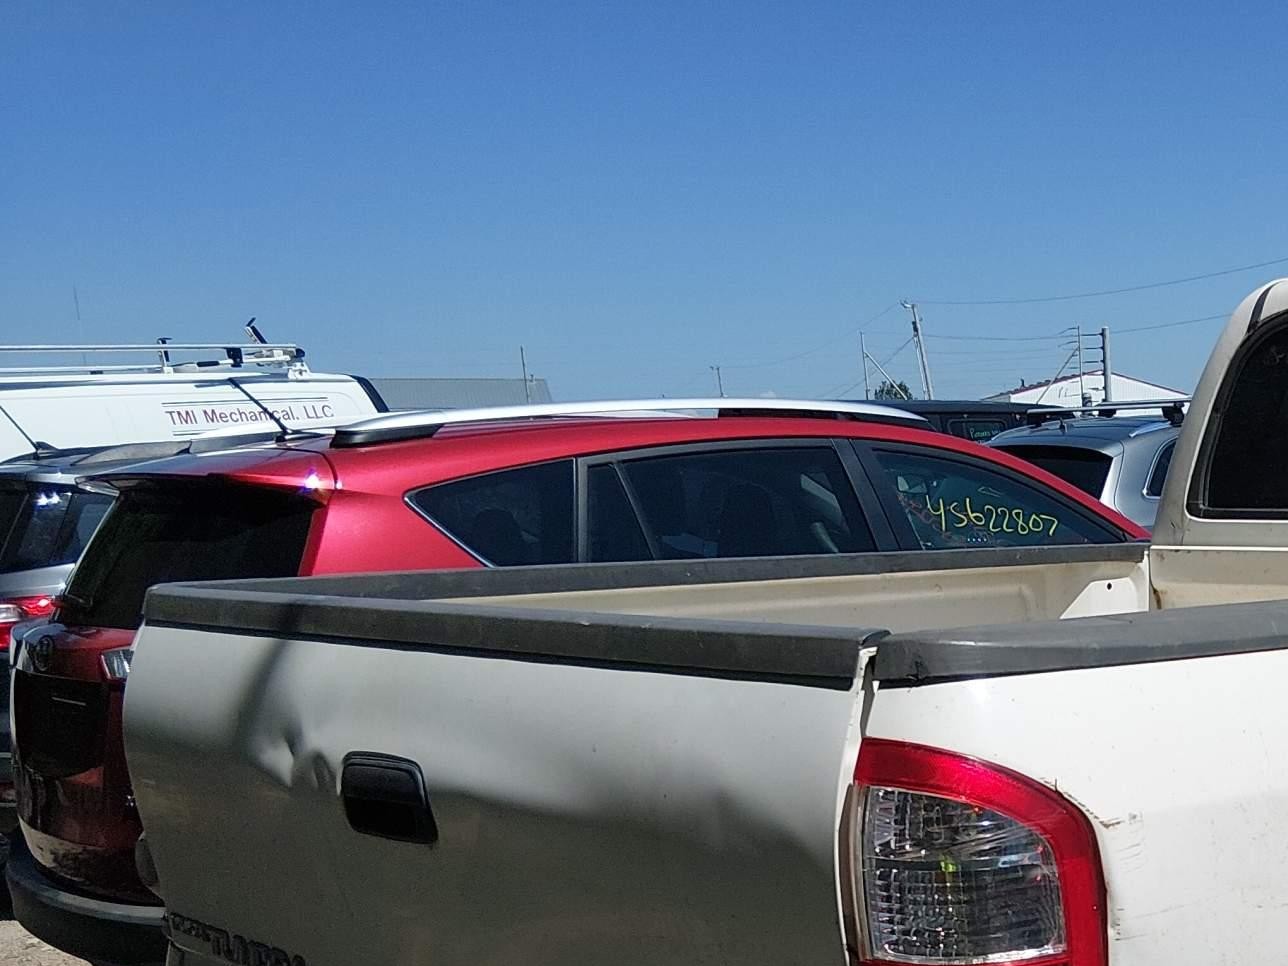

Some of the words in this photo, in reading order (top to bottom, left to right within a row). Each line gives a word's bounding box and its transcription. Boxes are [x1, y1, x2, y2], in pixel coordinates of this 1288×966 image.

[165, 409, 198, 426] TMI
[203, 405, 300, 424] Mechancal.
[304, 404, 335, 420] LLC
[925, 494, 1058, 537] 45622807
